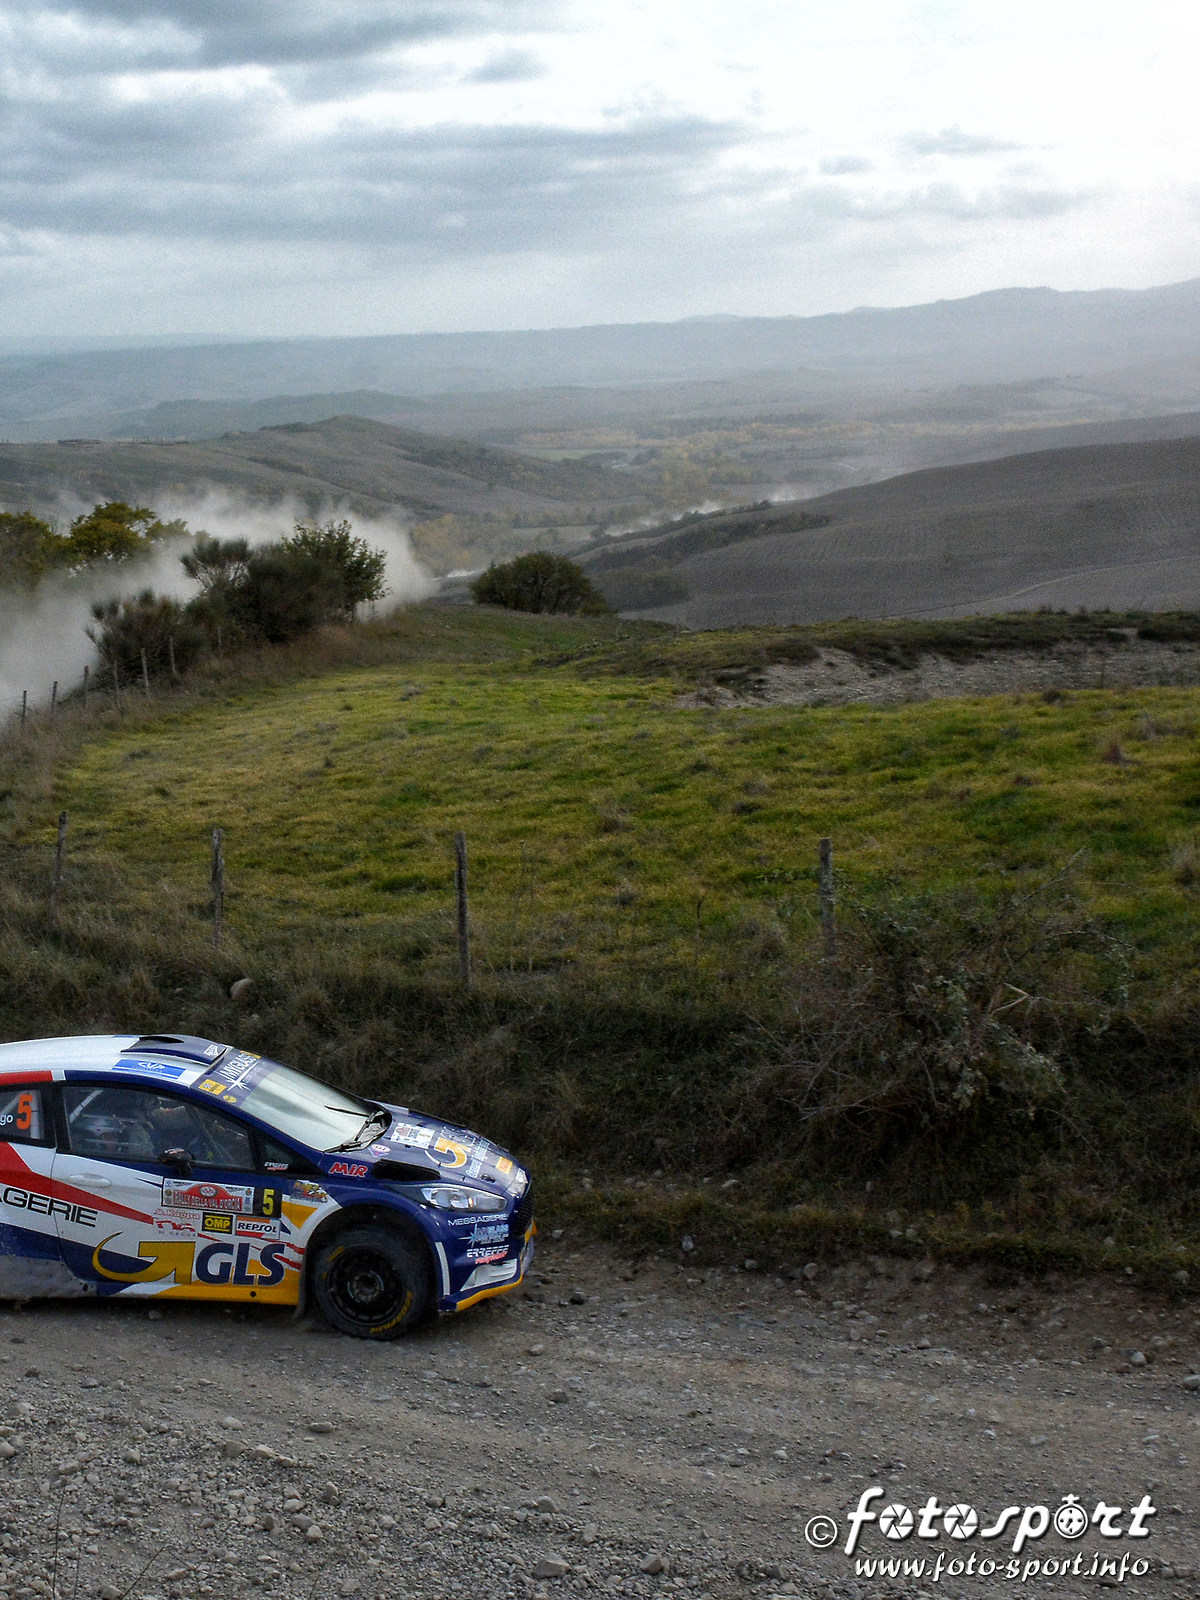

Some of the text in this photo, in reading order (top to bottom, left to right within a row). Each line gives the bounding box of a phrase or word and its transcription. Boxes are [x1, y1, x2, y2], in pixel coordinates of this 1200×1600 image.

[17, 1094, 33, 1130] 5
[262, 1188, 275, 1216] 5
[204, 1218, 231, 1229] OMP
[237, 1222, 278, 1233] REPSOL
[195, 1242, 286, 1286] GLS
